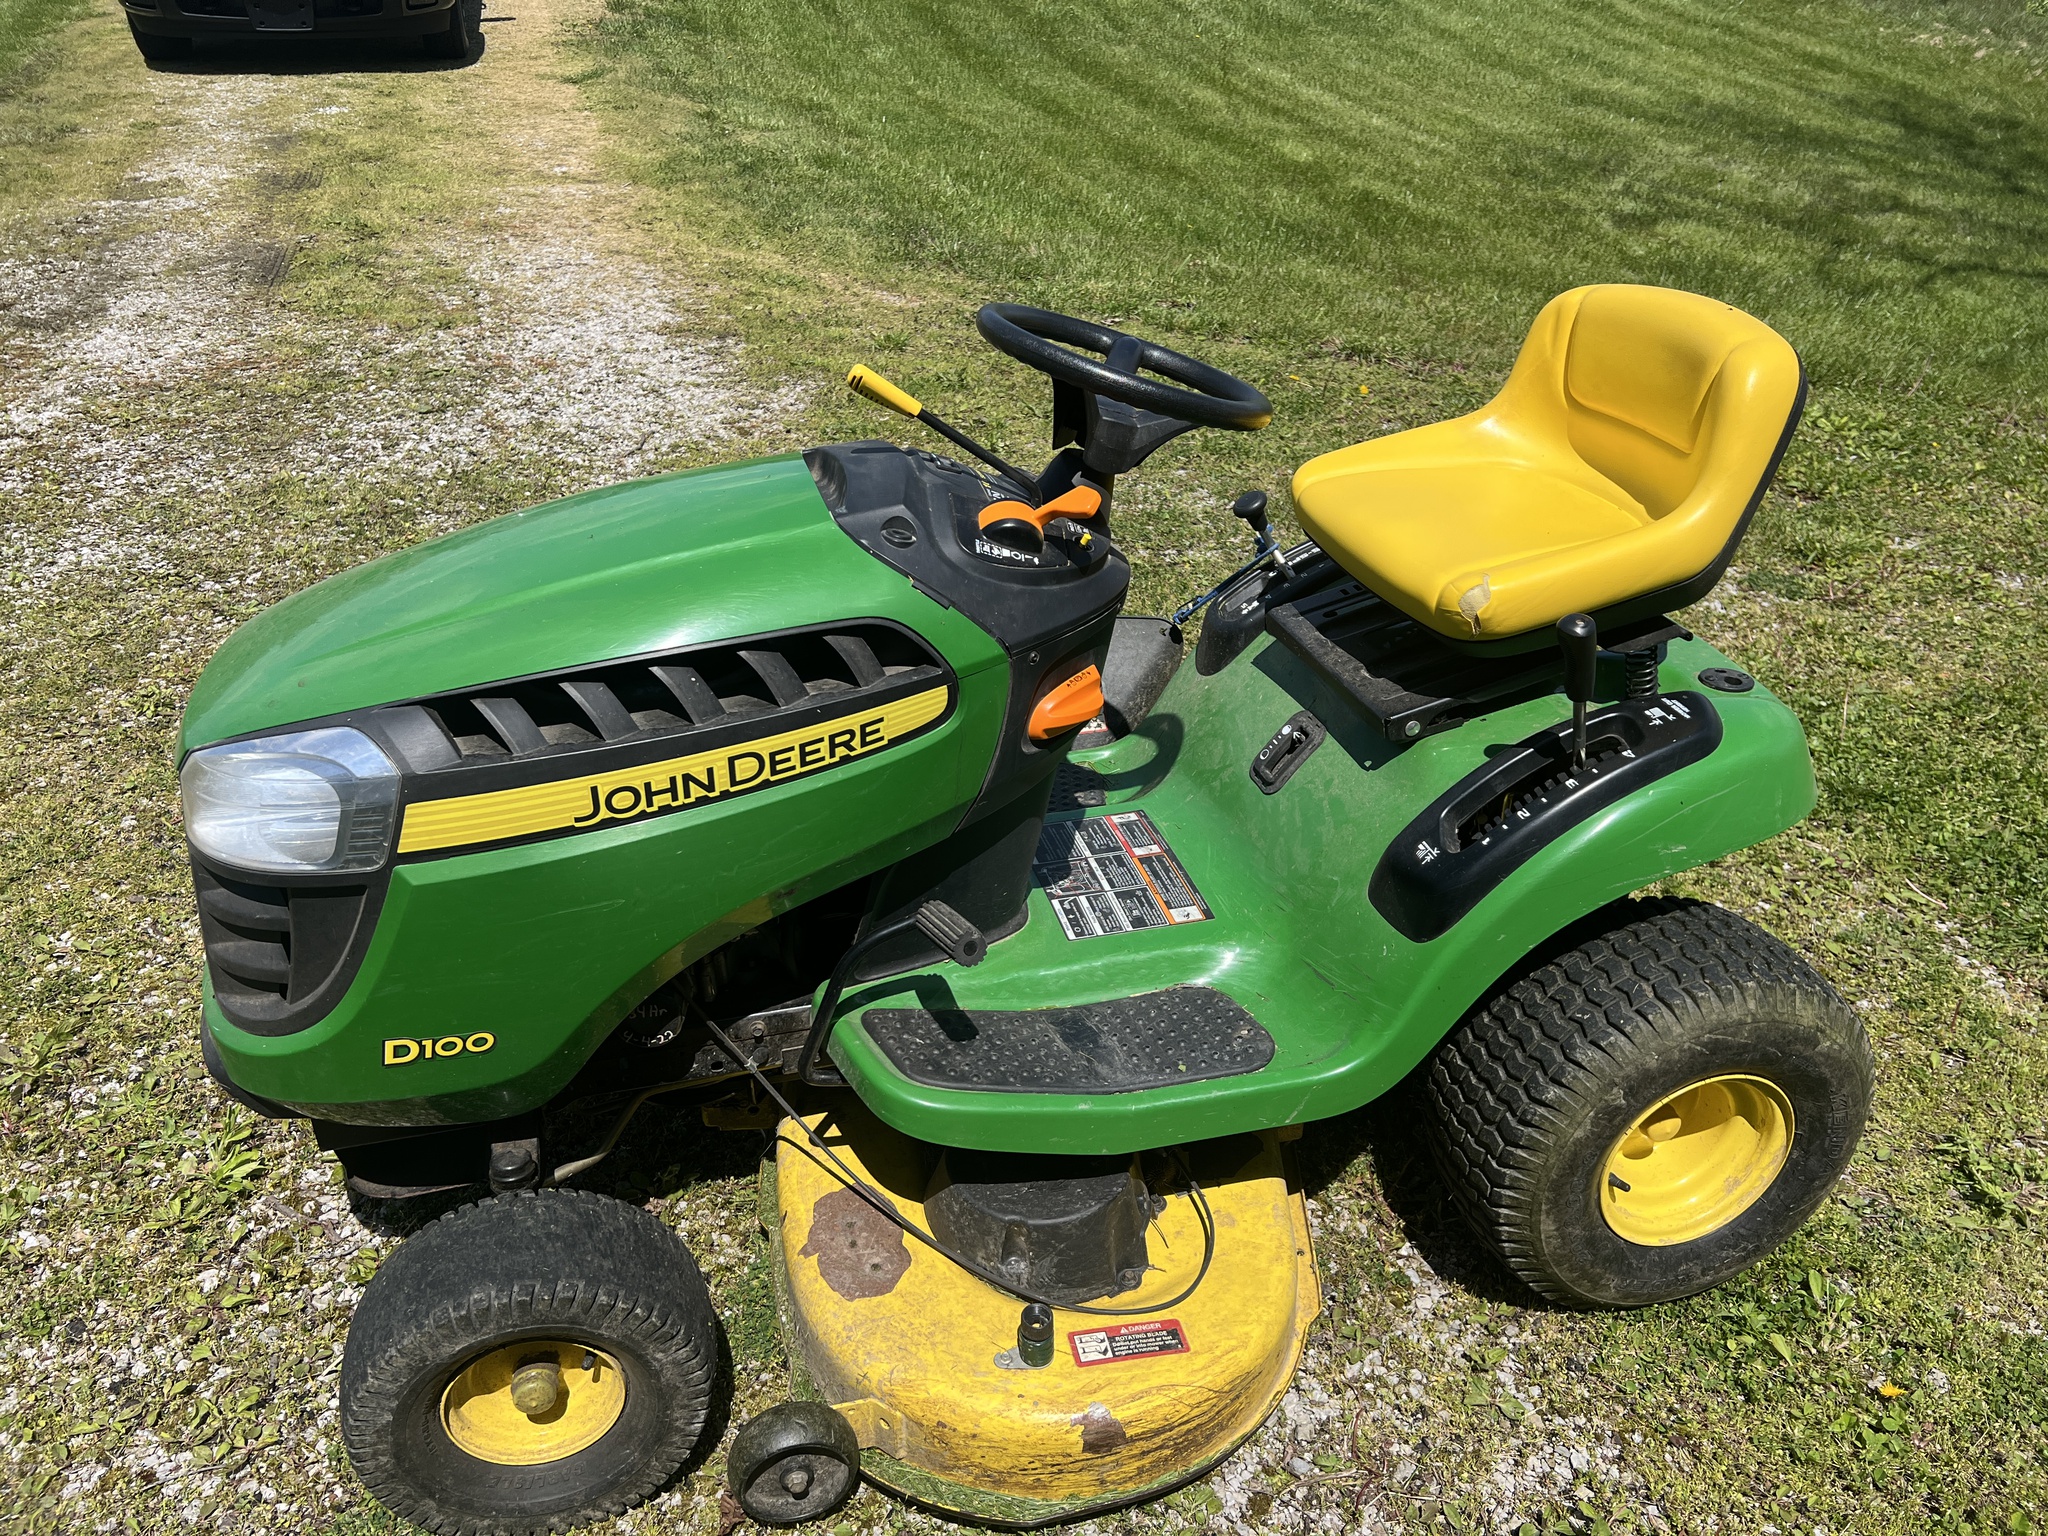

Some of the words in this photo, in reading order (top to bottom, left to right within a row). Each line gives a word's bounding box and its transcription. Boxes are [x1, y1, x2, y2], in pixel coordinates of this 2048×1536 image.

[1621, 749, 1635, 758] 4
[573, 766, 716, 824] JOHN
[727, 716, 886, 788] DEERE
[1565, 778, 1579, 789] 3
[1517, 807, 1531, 819] 2
[1482, 837, 1491, 845] 1
[383, 1032, 495, 1066] D100
[1128, 1322, 1162, 1332] DANGER
[1115, 1332, 1146, 1342] ROTATING
[1146, 1330, 1168, 1338] BLADE
